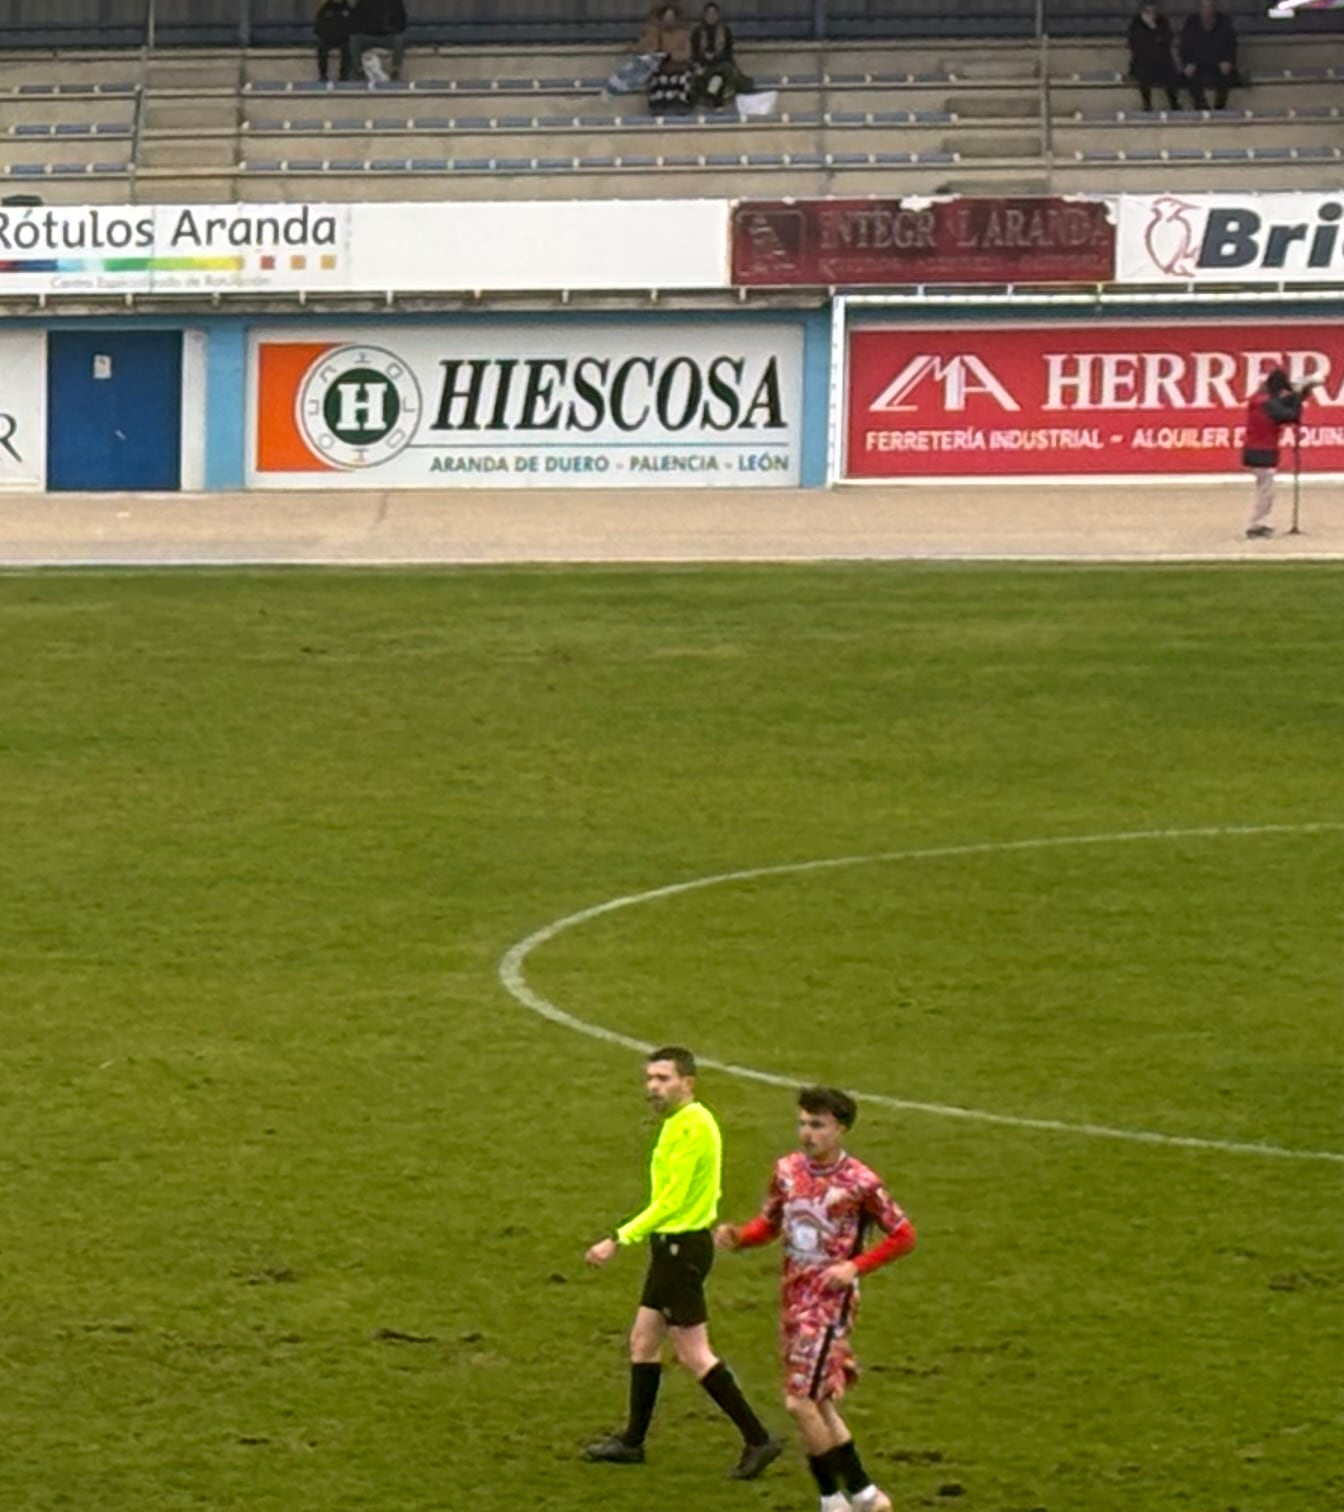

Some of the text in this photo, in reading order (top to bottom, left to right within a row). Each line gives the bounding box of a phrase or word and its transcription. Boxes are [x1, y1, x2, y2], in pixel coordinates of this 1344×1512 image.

[171, 206, 337, 247] Aranda
[429, 355, 788, 432] HIESCOSA
[1041, 351, 1344, 411] HERRER
[335, 382, 388, 432] H
[865, 427, 987, 451] FERRETERÍA
[989, 428, 1104, 450] INDUSTRIAL
[1132, 427, 1229, 450] ALQUILER
[429, 451, 790, 474] ARANDA DE DUERO PALENCIA LEÓN
